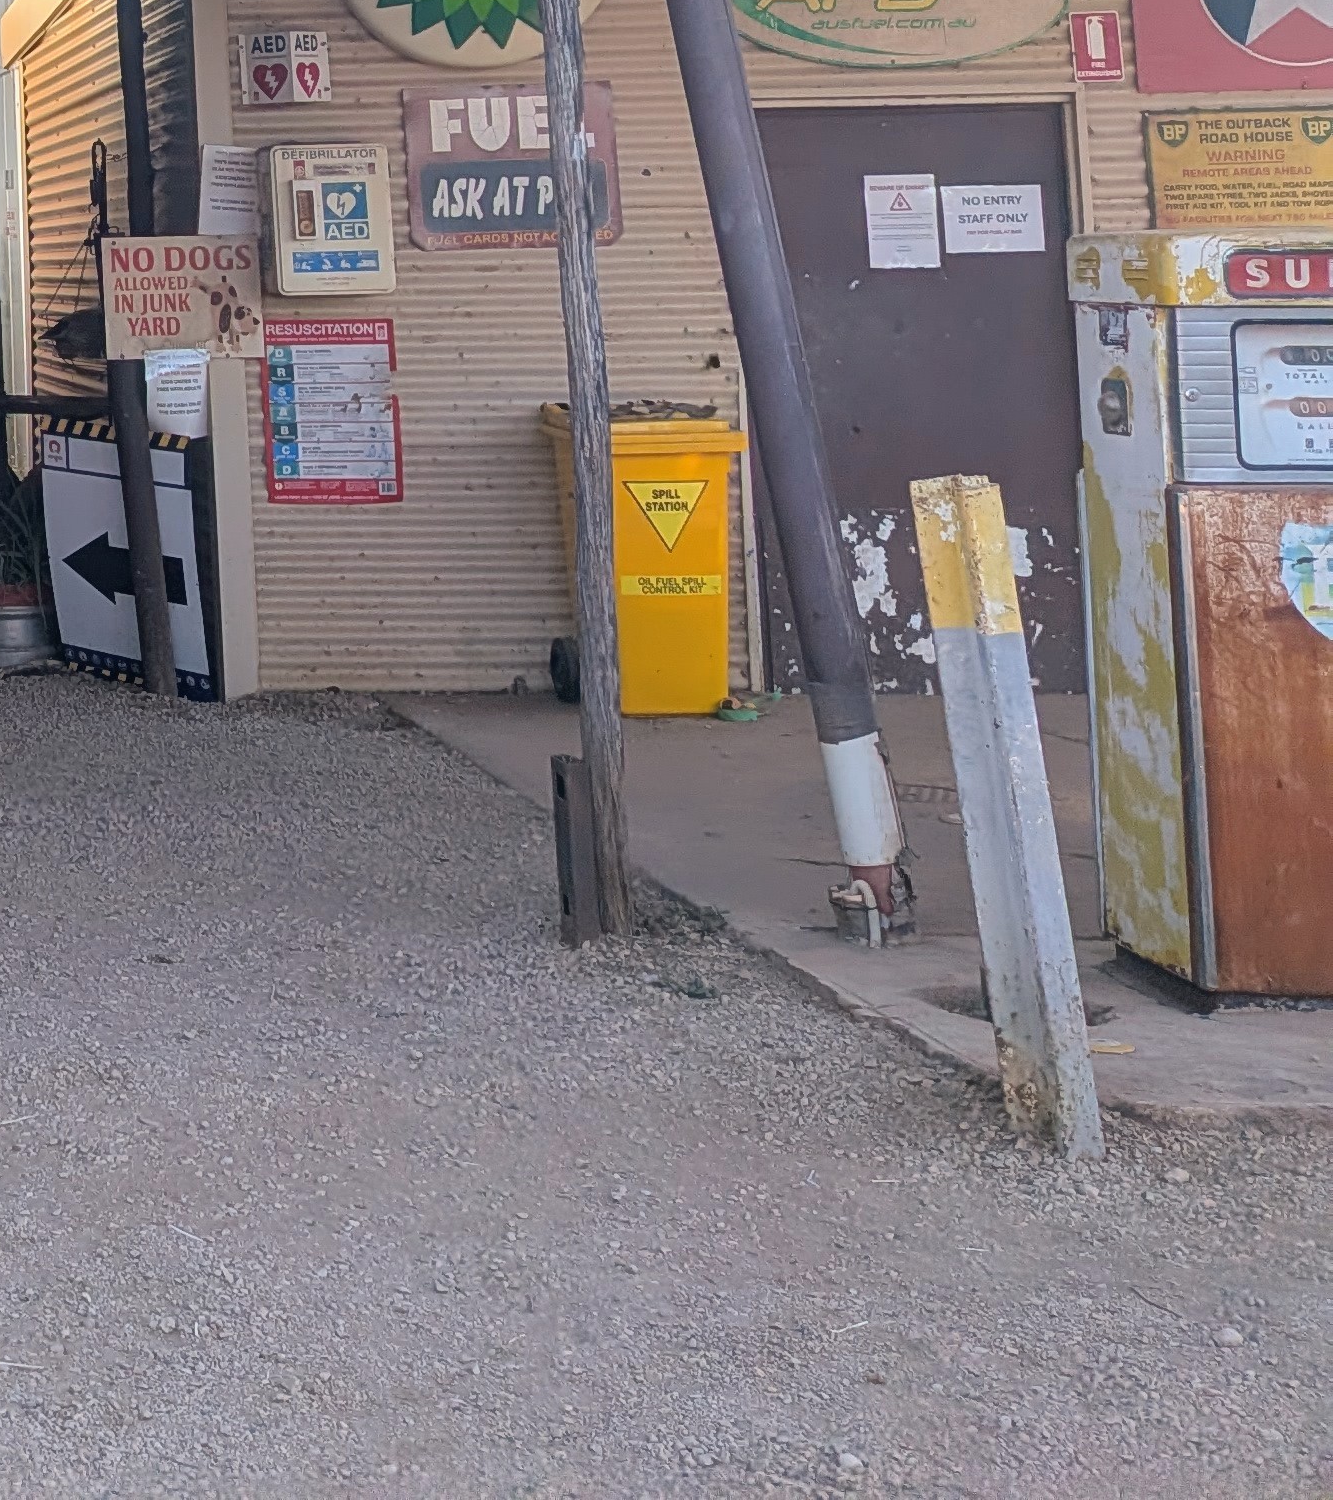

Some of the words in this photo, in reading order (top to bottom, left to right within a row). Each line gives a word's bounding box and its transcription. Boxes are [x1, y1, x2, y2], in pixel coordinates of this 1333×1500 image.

[250, 35, 286, 54] AED
[293, 33, 319, 53] AED
[429, 95, 596, 152] FUE
[1196, 120, 1222, 130] THE
[1226, 117, 1291, 130] OUTBACK
[1306, 120, 1331, 137] BP
[1162, 124, 1186, 140] BP
[1200, 133, 1239, 144] ROAD
[1244, 131, 1293, 143] HOUSE
[281, 149, 377, 160] DEFIBRILLATOR
[1206, 149, 1286, 163] WARNING
[1183, 168, 1229, 178] REMOTE
[1233, 168, 1271, 177] AREAS
[1274, 166, 1312, 176] AHEAD
[433, 178, 486, 220] ASK
[493, 176, 530, 217] AT
[961, 196, 981, 206] NO
[983, 195, 1022, 206] ENTRY
[958, 214, 993, 224] STAFF
[996, 213, 1028, 223] ONLY
[327, 223, 369, 240] AED
[110, 246, 155, 273] NO
[164, 245, 251, 271] DOGS
[114, 276, 188, 291] ALLOWED
[114, 294, 134, 314] IN
[141, 293, 191, 315] JUNK
[127, 316, 181, 337] YARD
[265, 322, 373, 336] RESUSCITATION
[281, 445, 291, 455] C
[282, 466, 291, 474] D
[651, 488, 681, 500] SPILL
[645, 501, 690, 512] STATION
[638, 577, 653, 587] OIL
[656, 577, 679, 587] FUEL
[682, 576, 707, 587] SPILL
[642, 585, 687, 595] CONTROL
[689, 585, 703, 594] KIT
